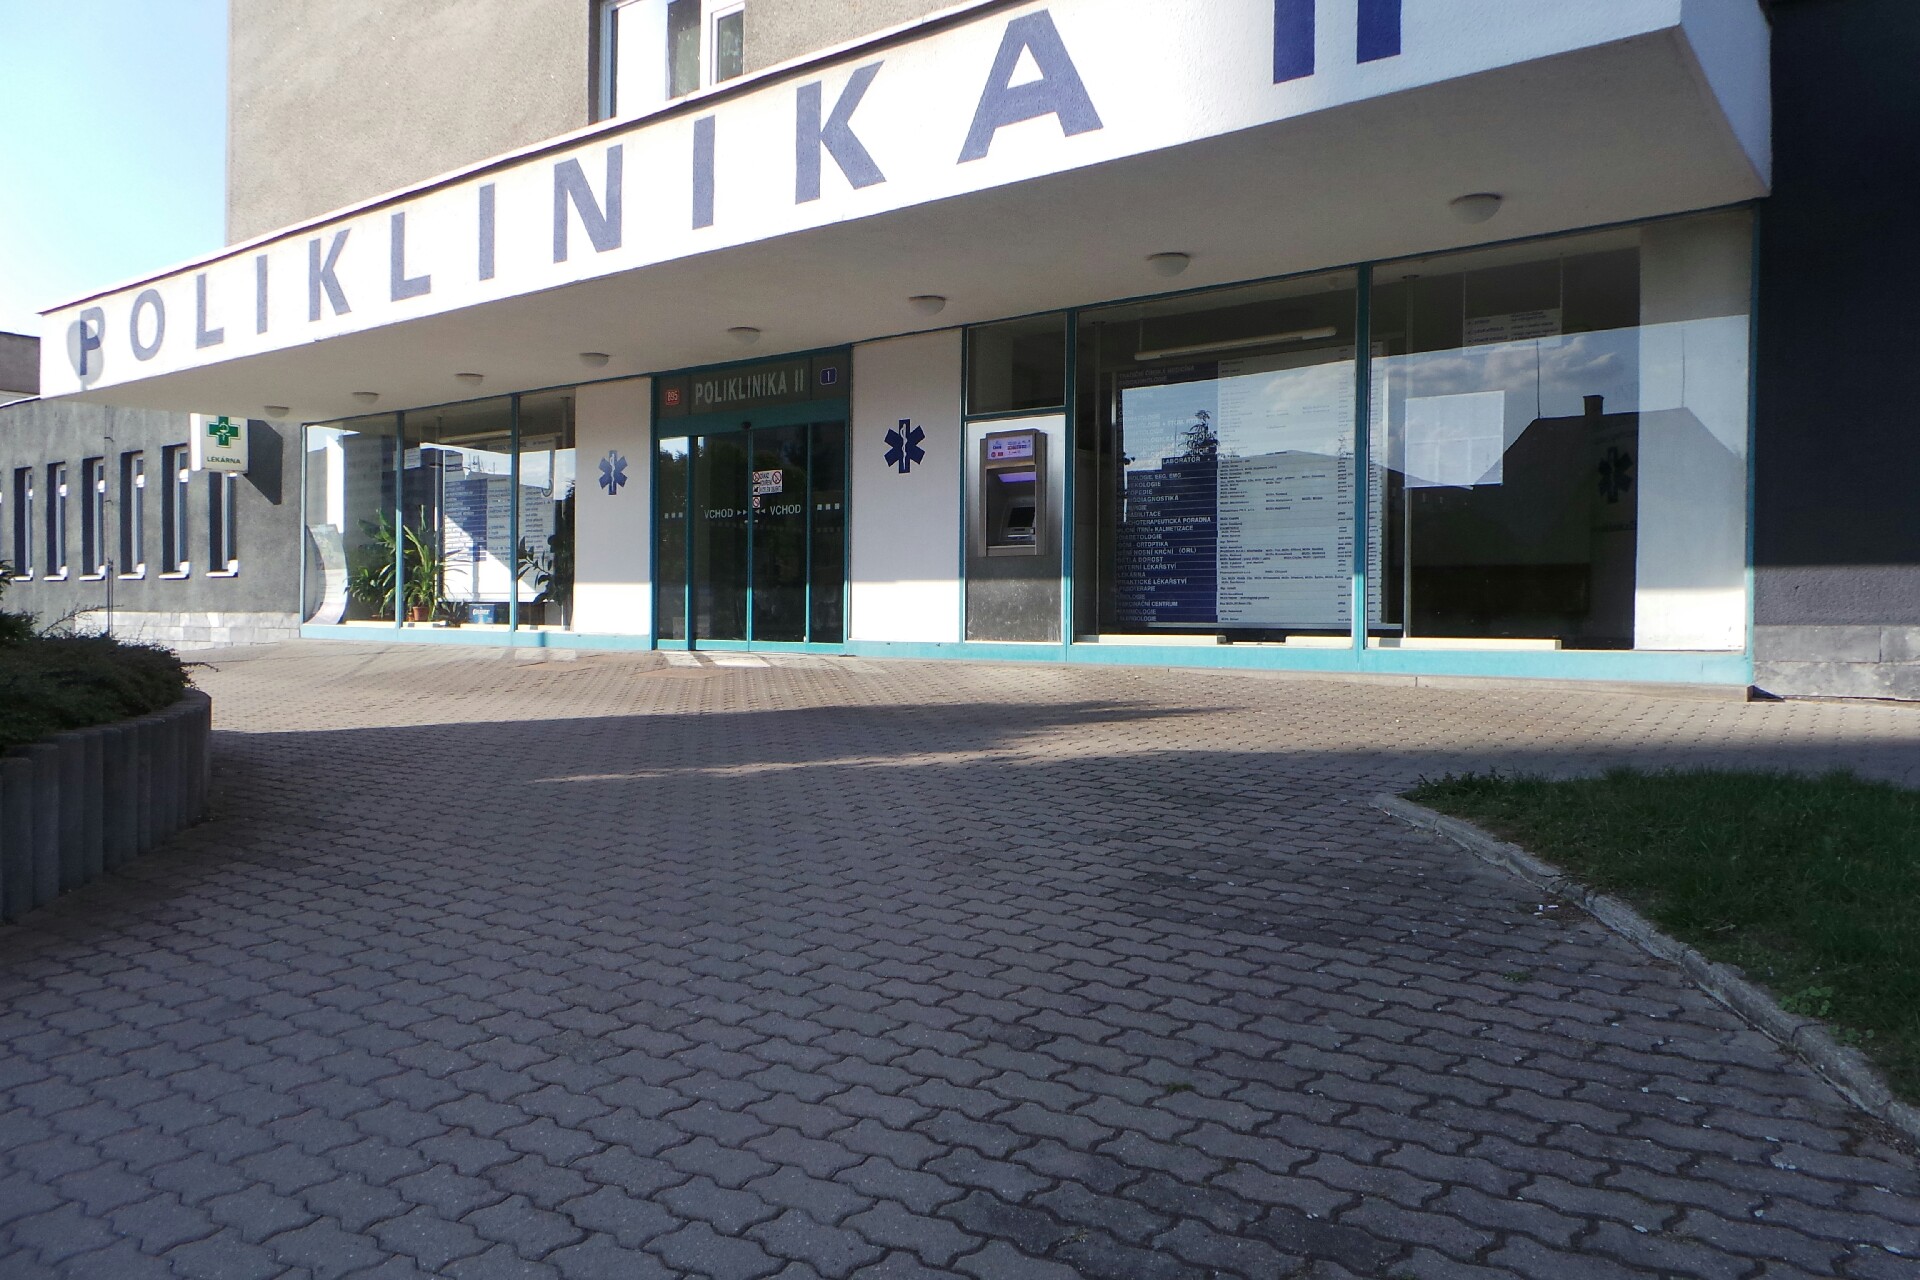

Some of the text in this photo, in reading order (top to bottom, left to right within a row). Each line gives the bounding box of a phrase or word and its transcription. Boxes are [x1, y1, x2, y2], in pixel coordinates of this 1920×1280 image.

[78, 10, 1104, 377] POLIKLINIKA
[695, 368, 804, 405] POLIKLINIKA II
[704, 508, 734, 519] VCHOD
[769, 504, 801, 516] VCHOD
[1153, 577, 1187, 585] LÉKAŘSTVÍ
